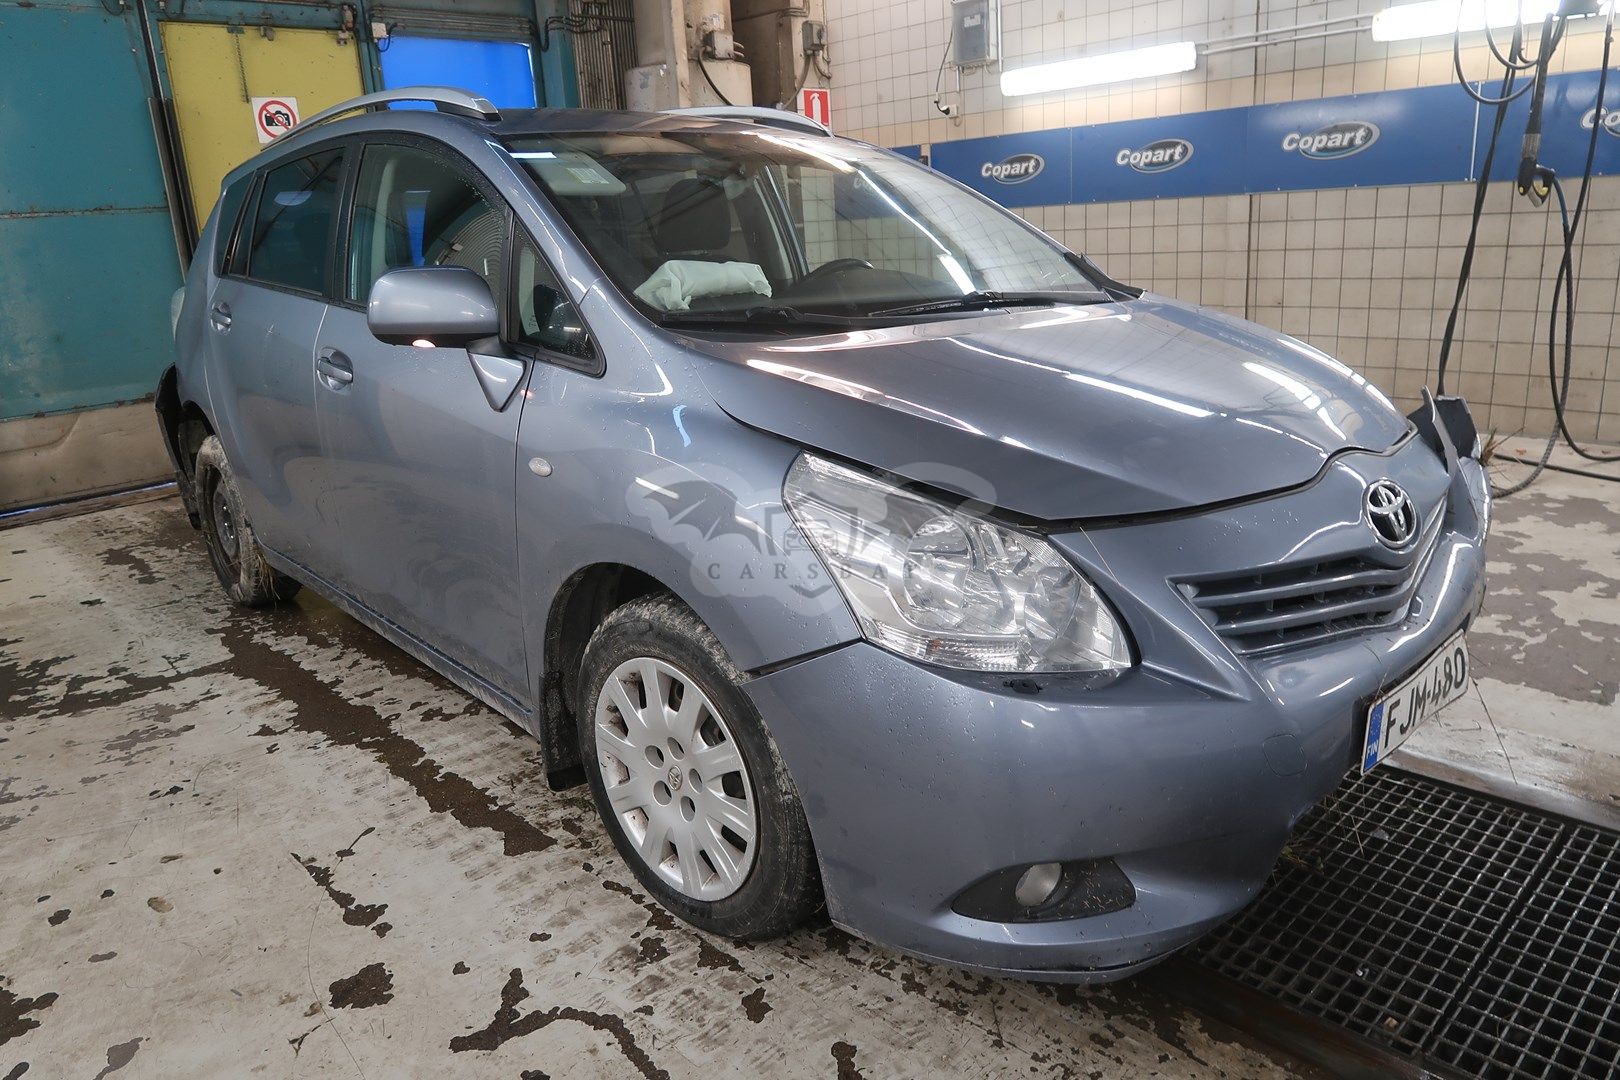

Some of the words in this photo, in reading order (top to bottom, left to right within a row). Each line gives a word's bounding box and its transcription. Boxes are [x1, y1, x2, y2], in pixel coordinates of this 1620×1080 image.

[1282, 126, 1369, 152] Copart
[1116, 142, 1186, 167] Copart
[981, 157, 1037, 179] Copart
[1384, 647, 1466, 749] FJM-480
[1366, 740, 1379, 760] FIN
